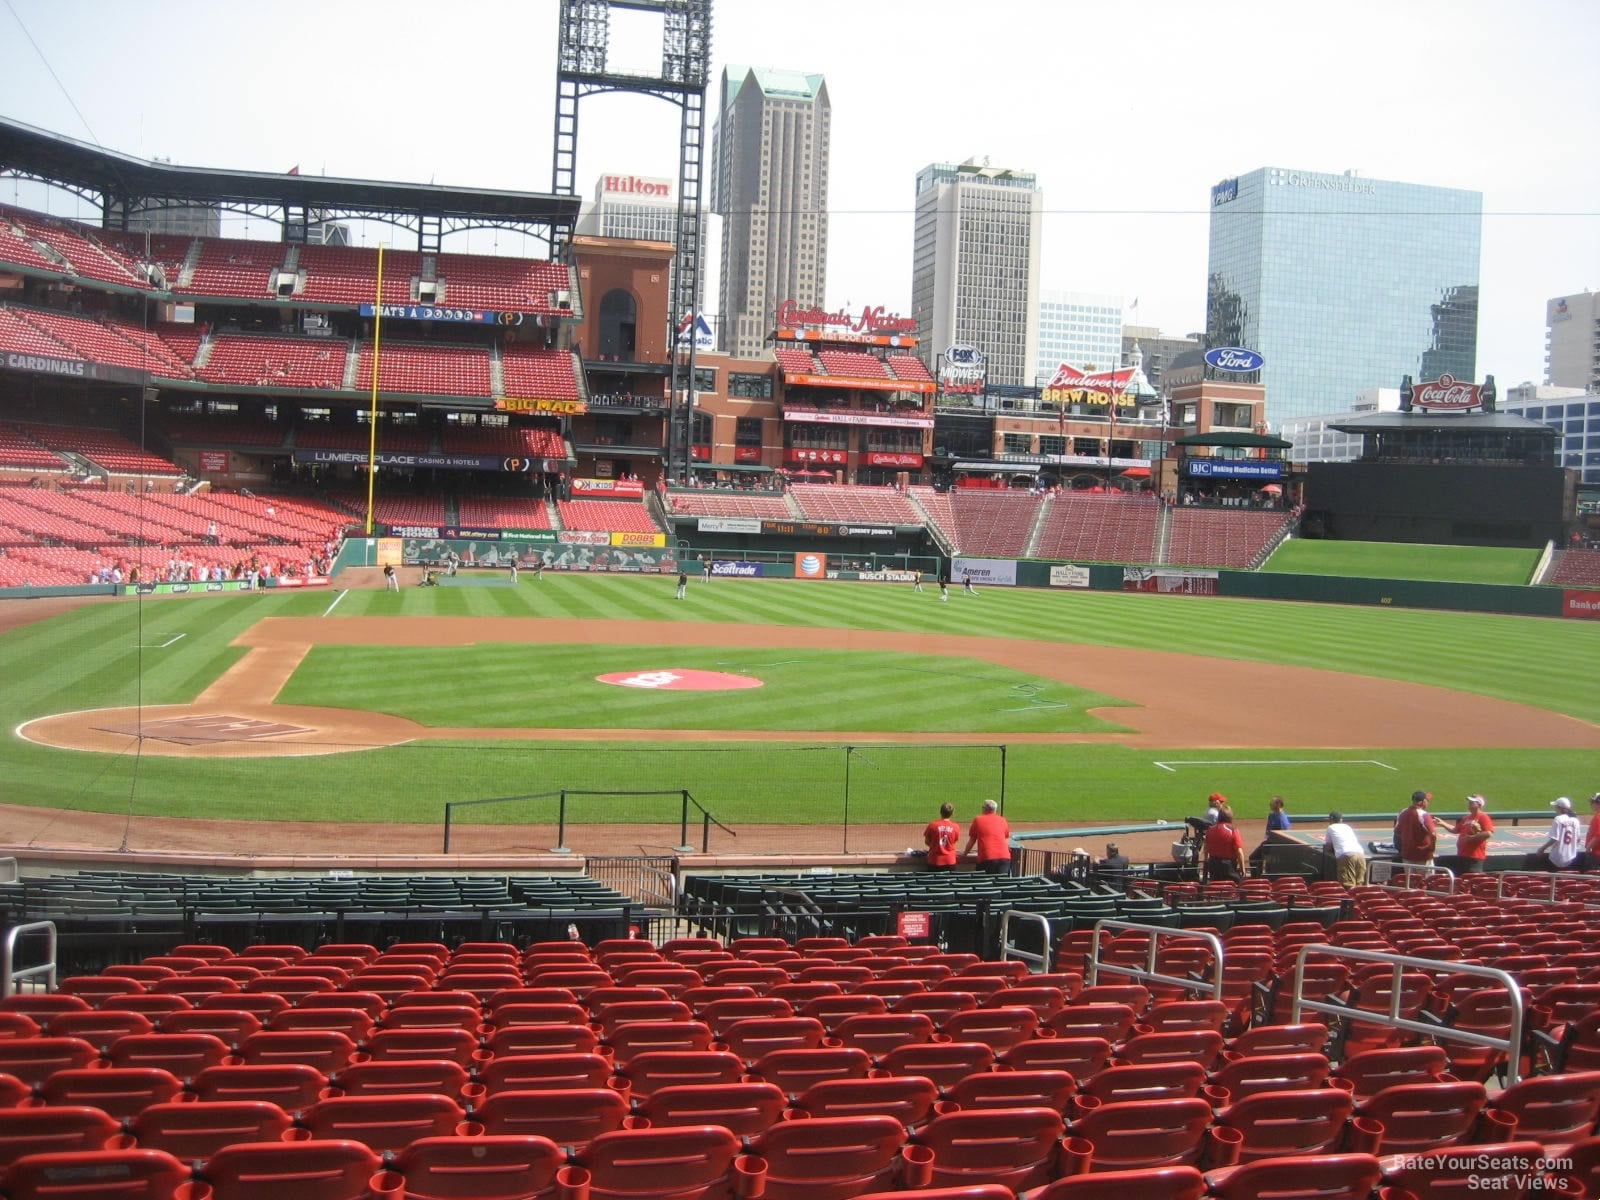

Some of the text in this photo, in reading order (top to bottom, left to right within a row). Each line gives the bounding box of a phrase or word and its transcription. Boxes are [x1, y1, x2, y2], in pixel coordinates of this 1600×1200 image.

[604, 175, 669, 196] Hilton
[1288, 174, 1377, 195] GREENSFELDER
[411, 308, 418, 318] A
[778, 299, 917, 332] Cardinals Nation
[952, 348, 975, 360] FOX
[1216, 349, 1253, 368] Ford
[9, 354, 84, 375] CARDINALS
[940, 366, 985, 379] MIDWEST
[1042, 388, 1136, 407] BREW HOUSE
[506, 400, 577, 414] BIG MAC
[373, 455, 415, 464] PLACE
[1192, 464, 1209, 473] BJC
[1212, 465, 1233, 473] Making
[1233, 466, 1260, 474] Medicine
[622, 533, 655, 542] DOBBS
[711, 563, 757, 575] Scottrade
[961, 567, 991, 577] Ameren
[858, 572, 885, 580] BUSCH
[1570, 599, 1590, 609] Bank
[1563, 830, 1572, 845] 6
